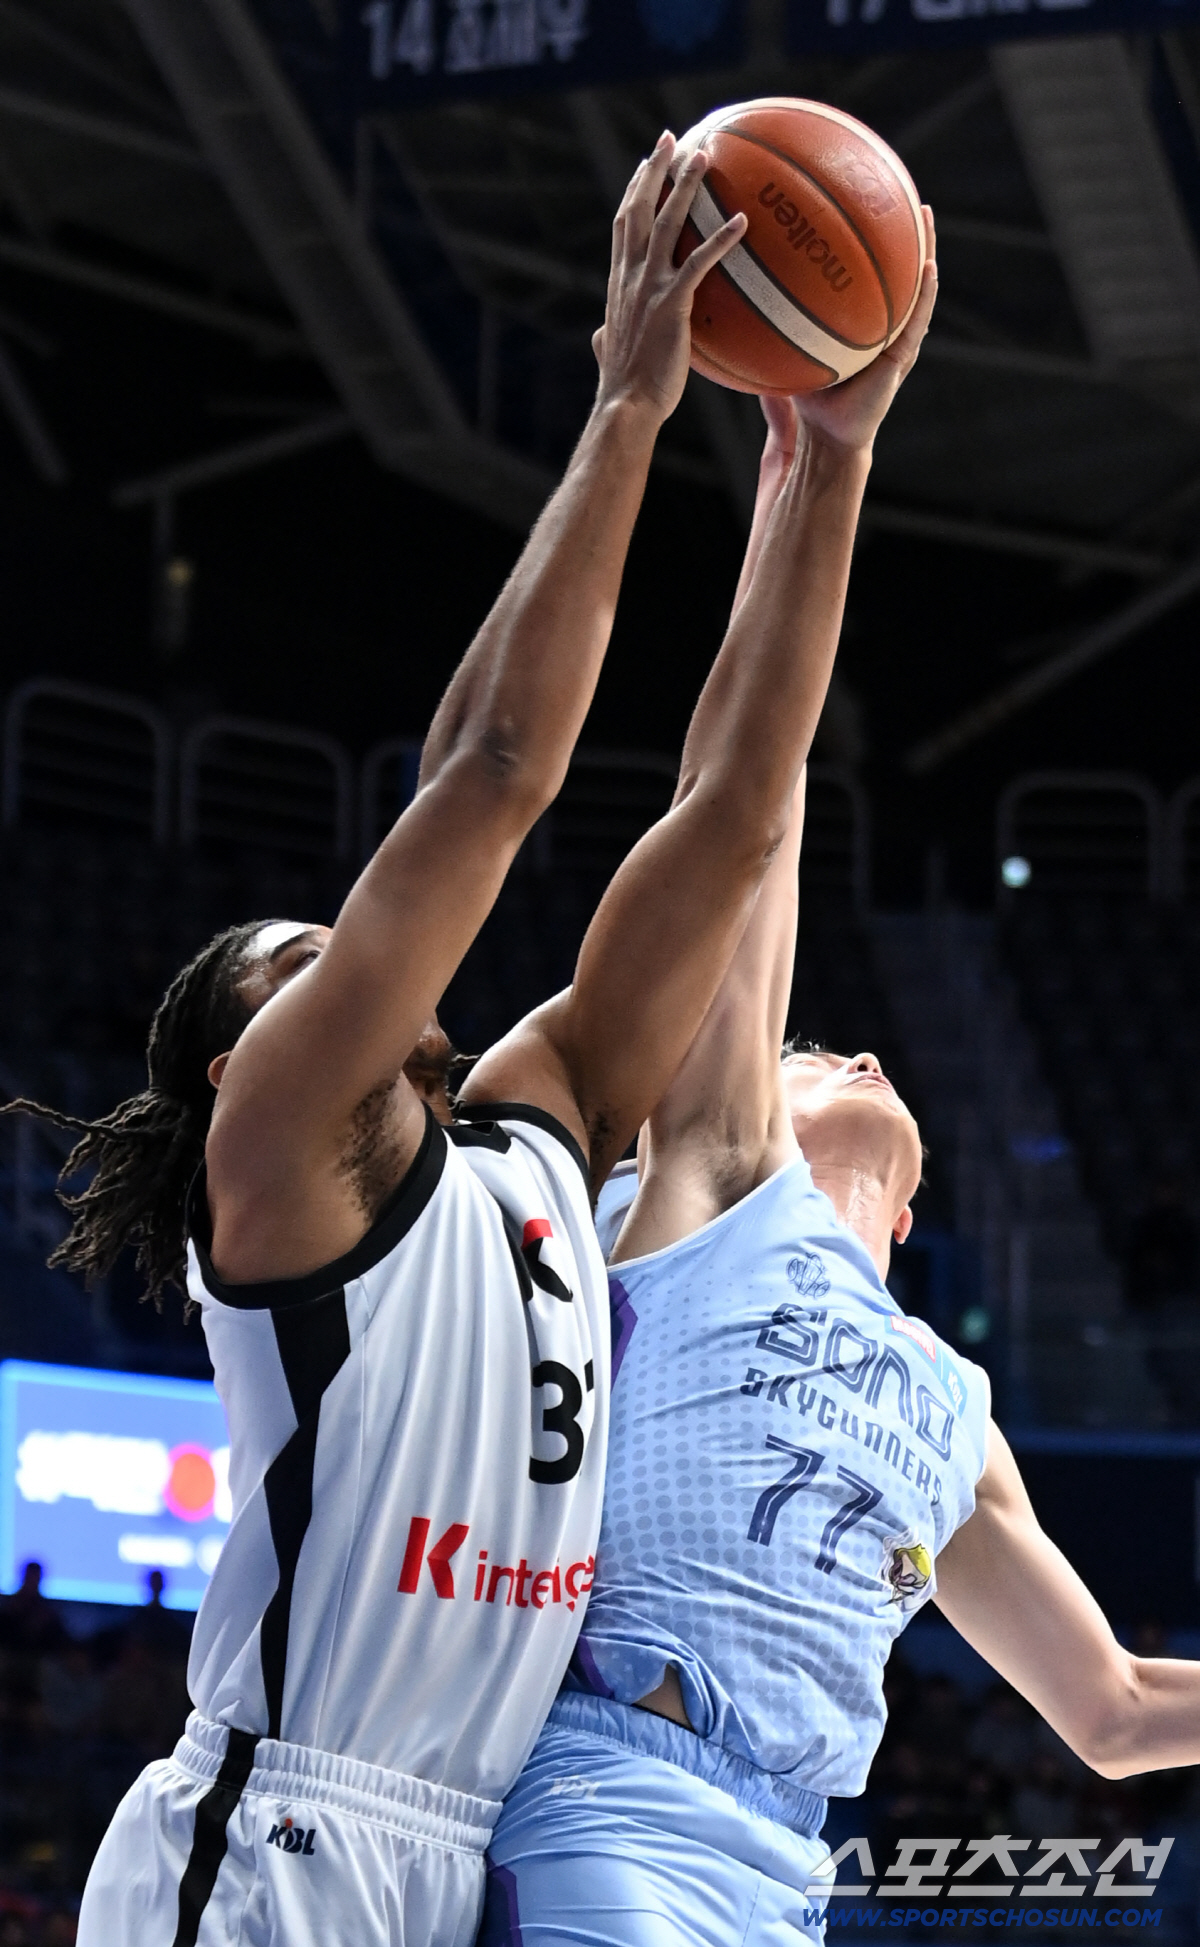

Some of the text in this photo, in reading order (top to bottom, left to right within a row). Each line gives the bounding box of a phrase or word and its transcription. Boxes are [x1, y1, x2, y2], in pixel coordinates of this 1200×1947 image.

[363, 1, 434, 79] 14
[757, 182, 853, 292] molten
[529, 1359, 594, 1485] 3
[740, 1367, 943, 1506] SKYGUNNERS
[747, 1433, 884, 1576] 77
[265, 1818, 317, 1856] KBL
